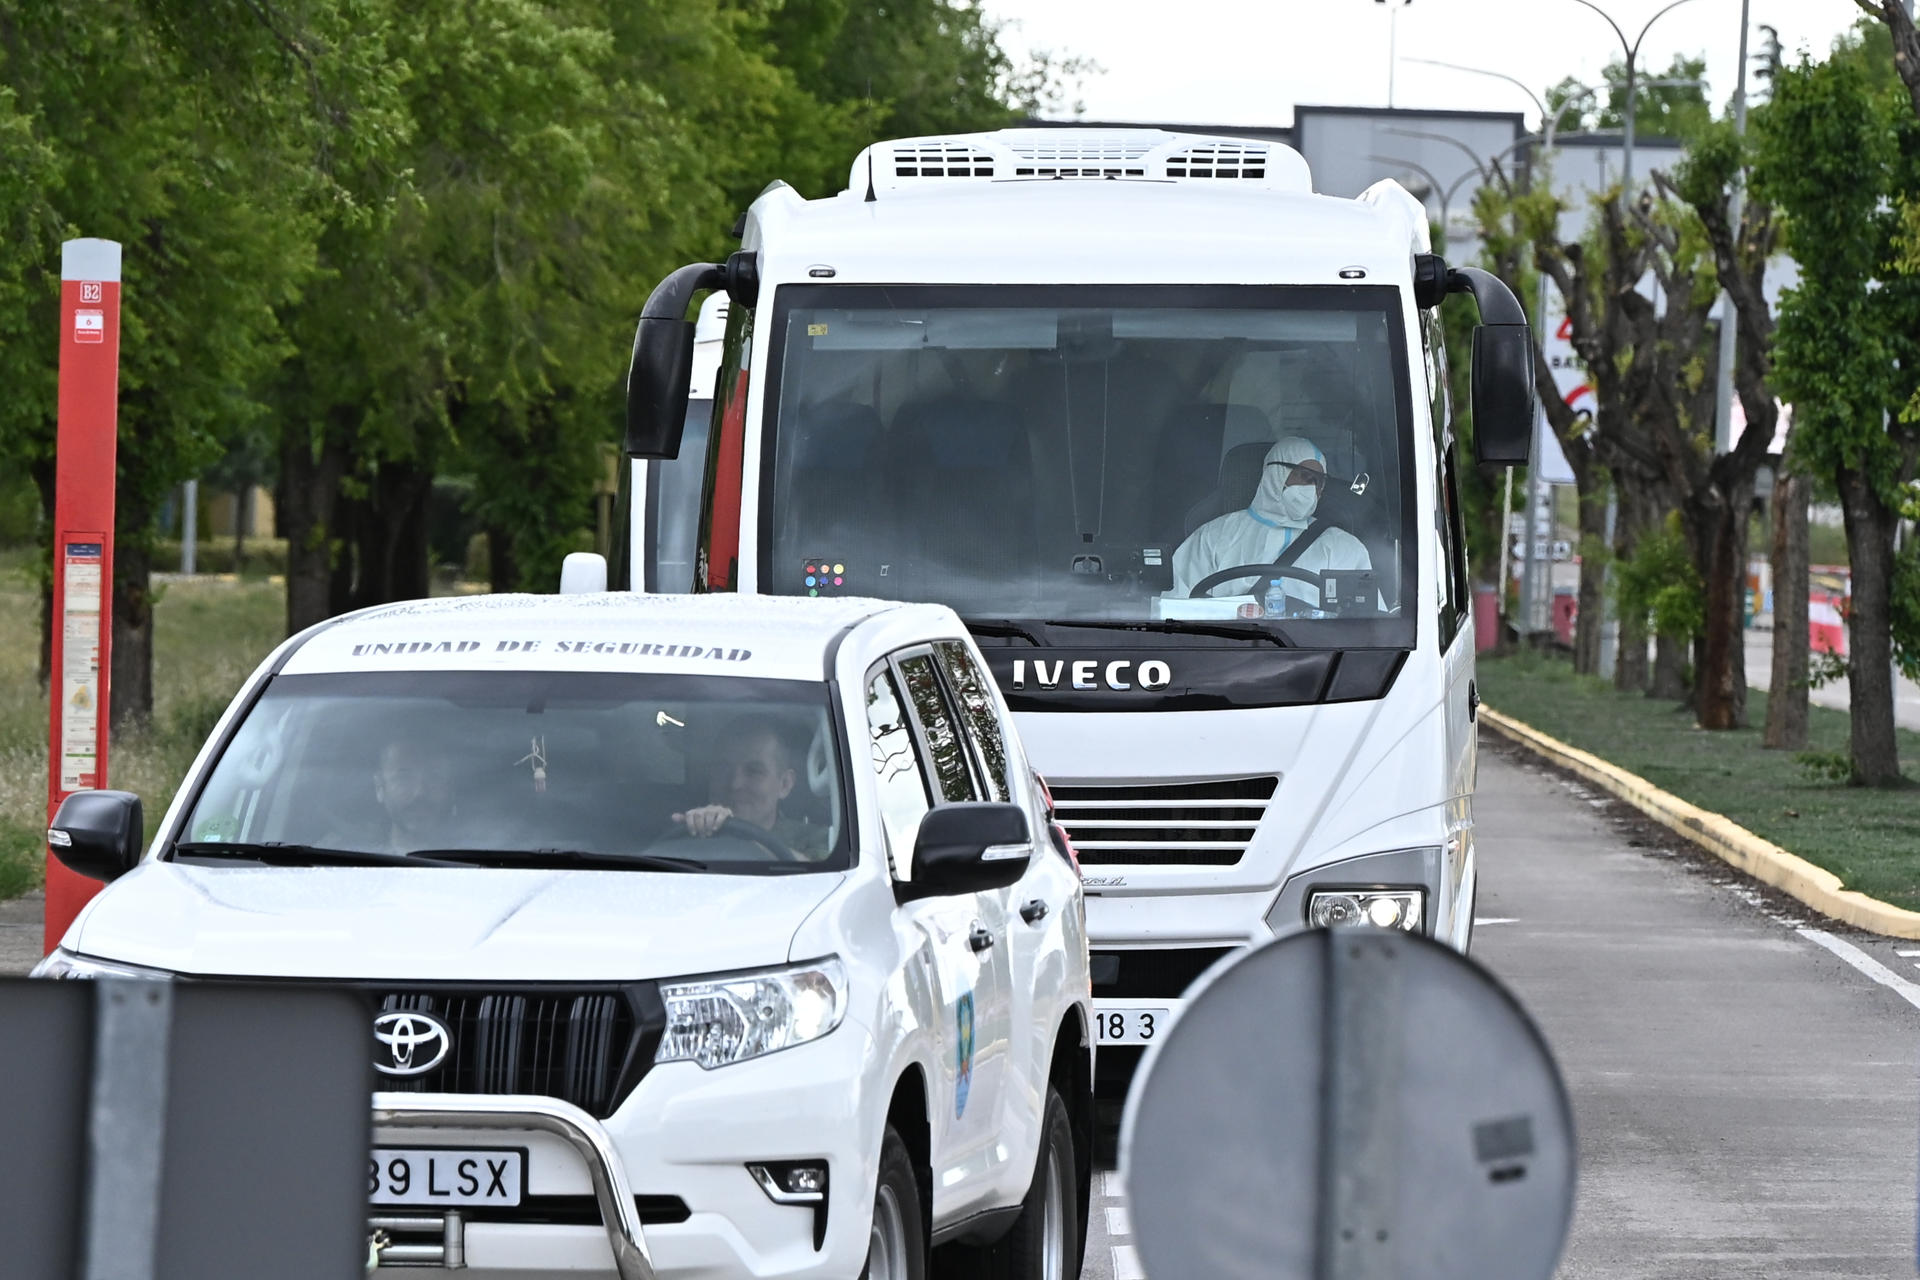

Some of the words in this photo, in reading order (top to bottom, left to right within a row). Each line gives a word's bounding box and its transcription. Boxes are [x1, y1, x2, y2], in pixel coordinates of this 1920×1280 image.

[84, 284, 99, 300] B2
[352, 641, 481, 657] UNIDAD
[495, 640, 541, 653] DE
[554, 640, 752, 662] SEGURIDAD
[1012, 659, 1171, 691] IVECO
[1096, 1013, 1125, 1040] 18
[1139, 1013, 1155, 1040] 3
[428, 1158, 508, 1198] LSX
